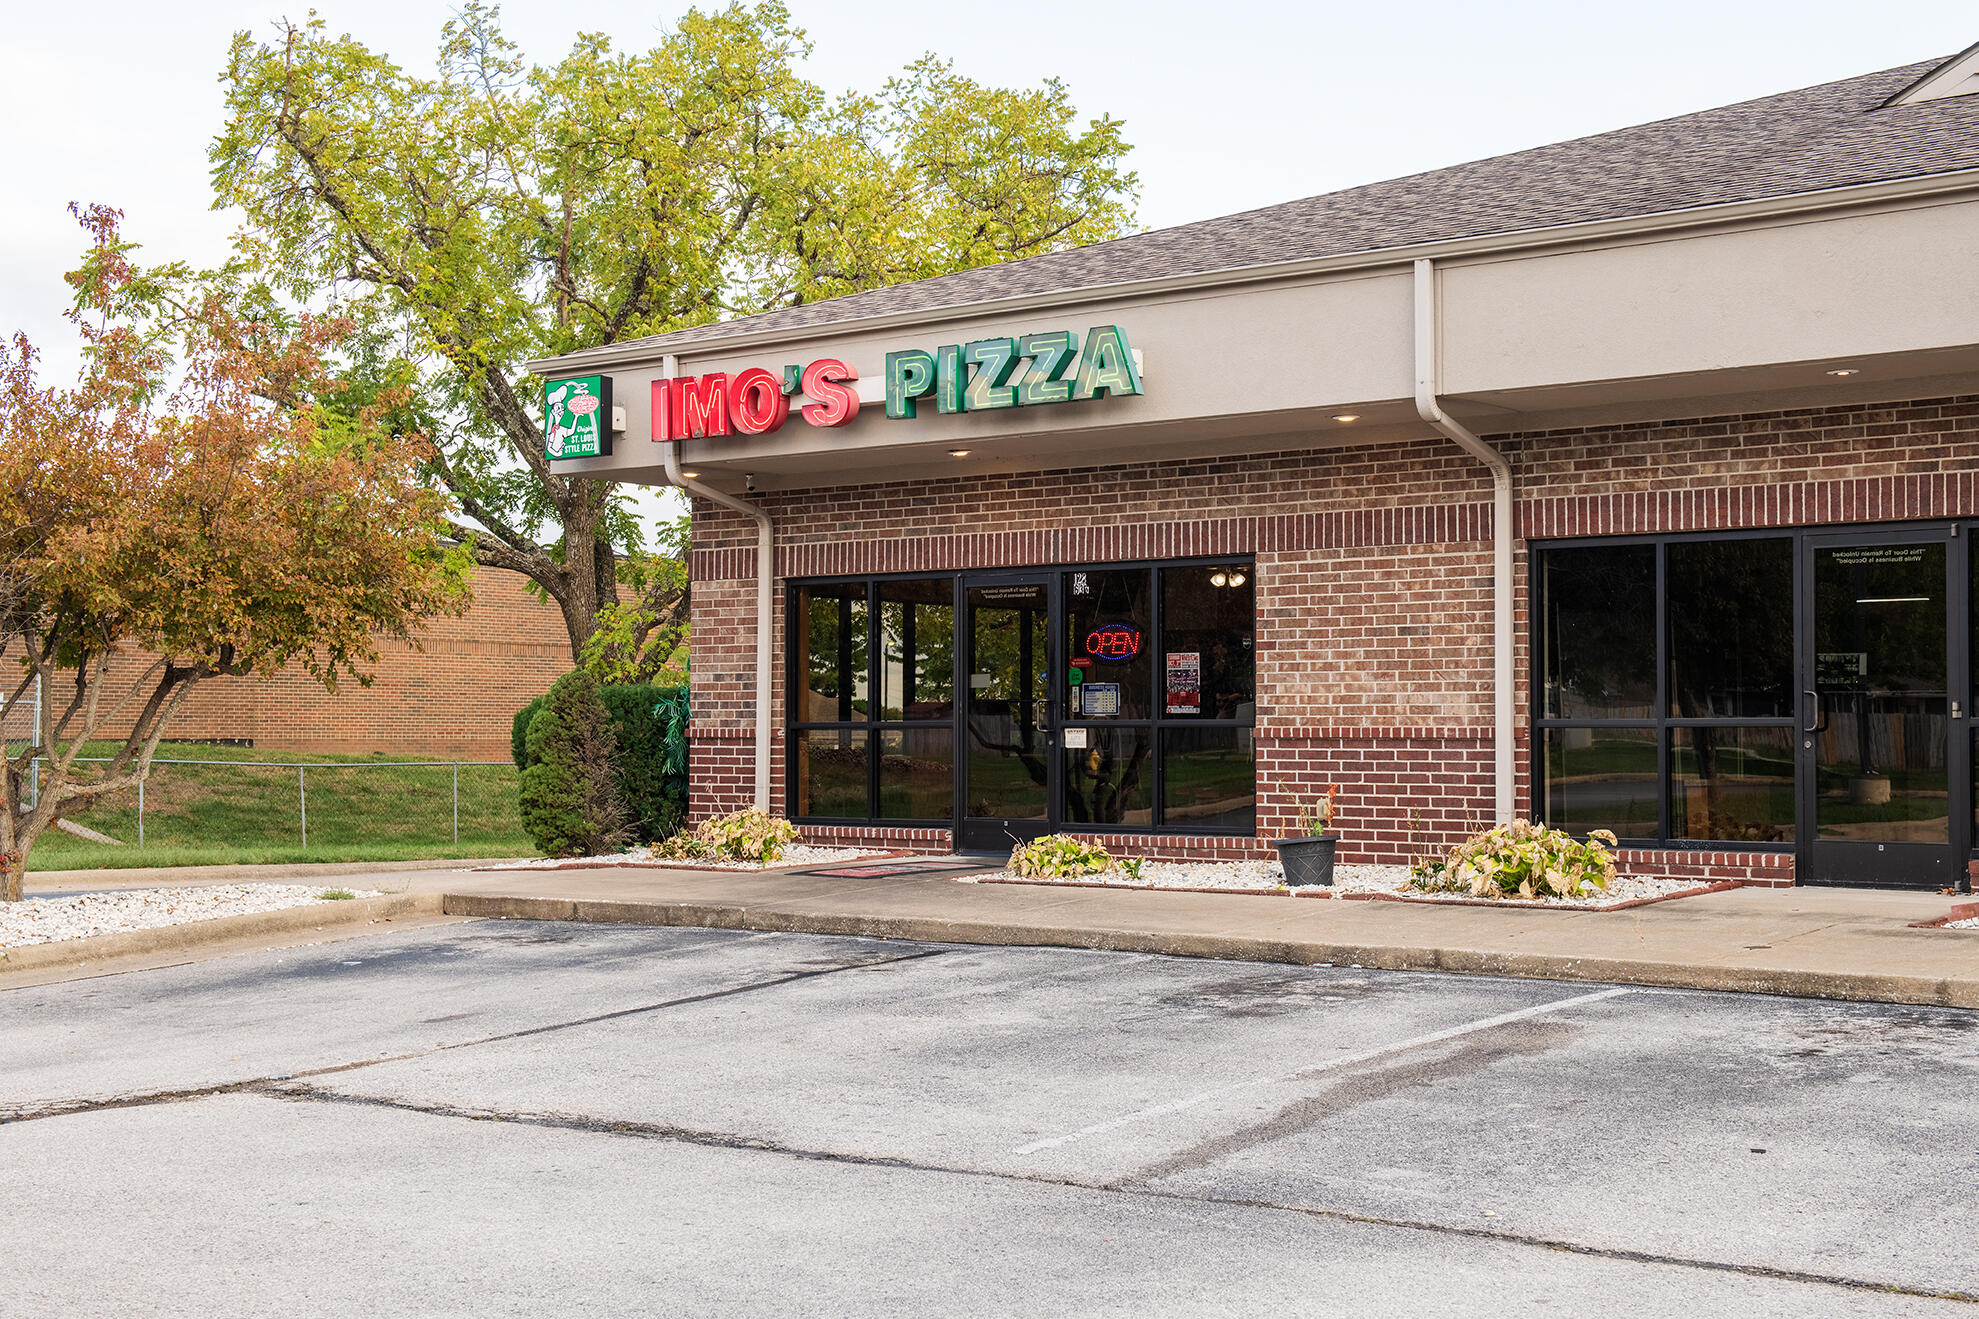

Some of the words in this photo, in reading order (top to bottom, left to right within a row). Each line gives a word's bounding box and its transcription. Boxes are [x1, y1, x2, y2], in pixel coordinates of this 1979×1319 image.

[651, 358, 860, 443] IMO'S
[886, 325, 1144, 419] PIZZA
[565, 444, 580, 454] STYLE
[1086, 631, 1140, 655] OPEN
